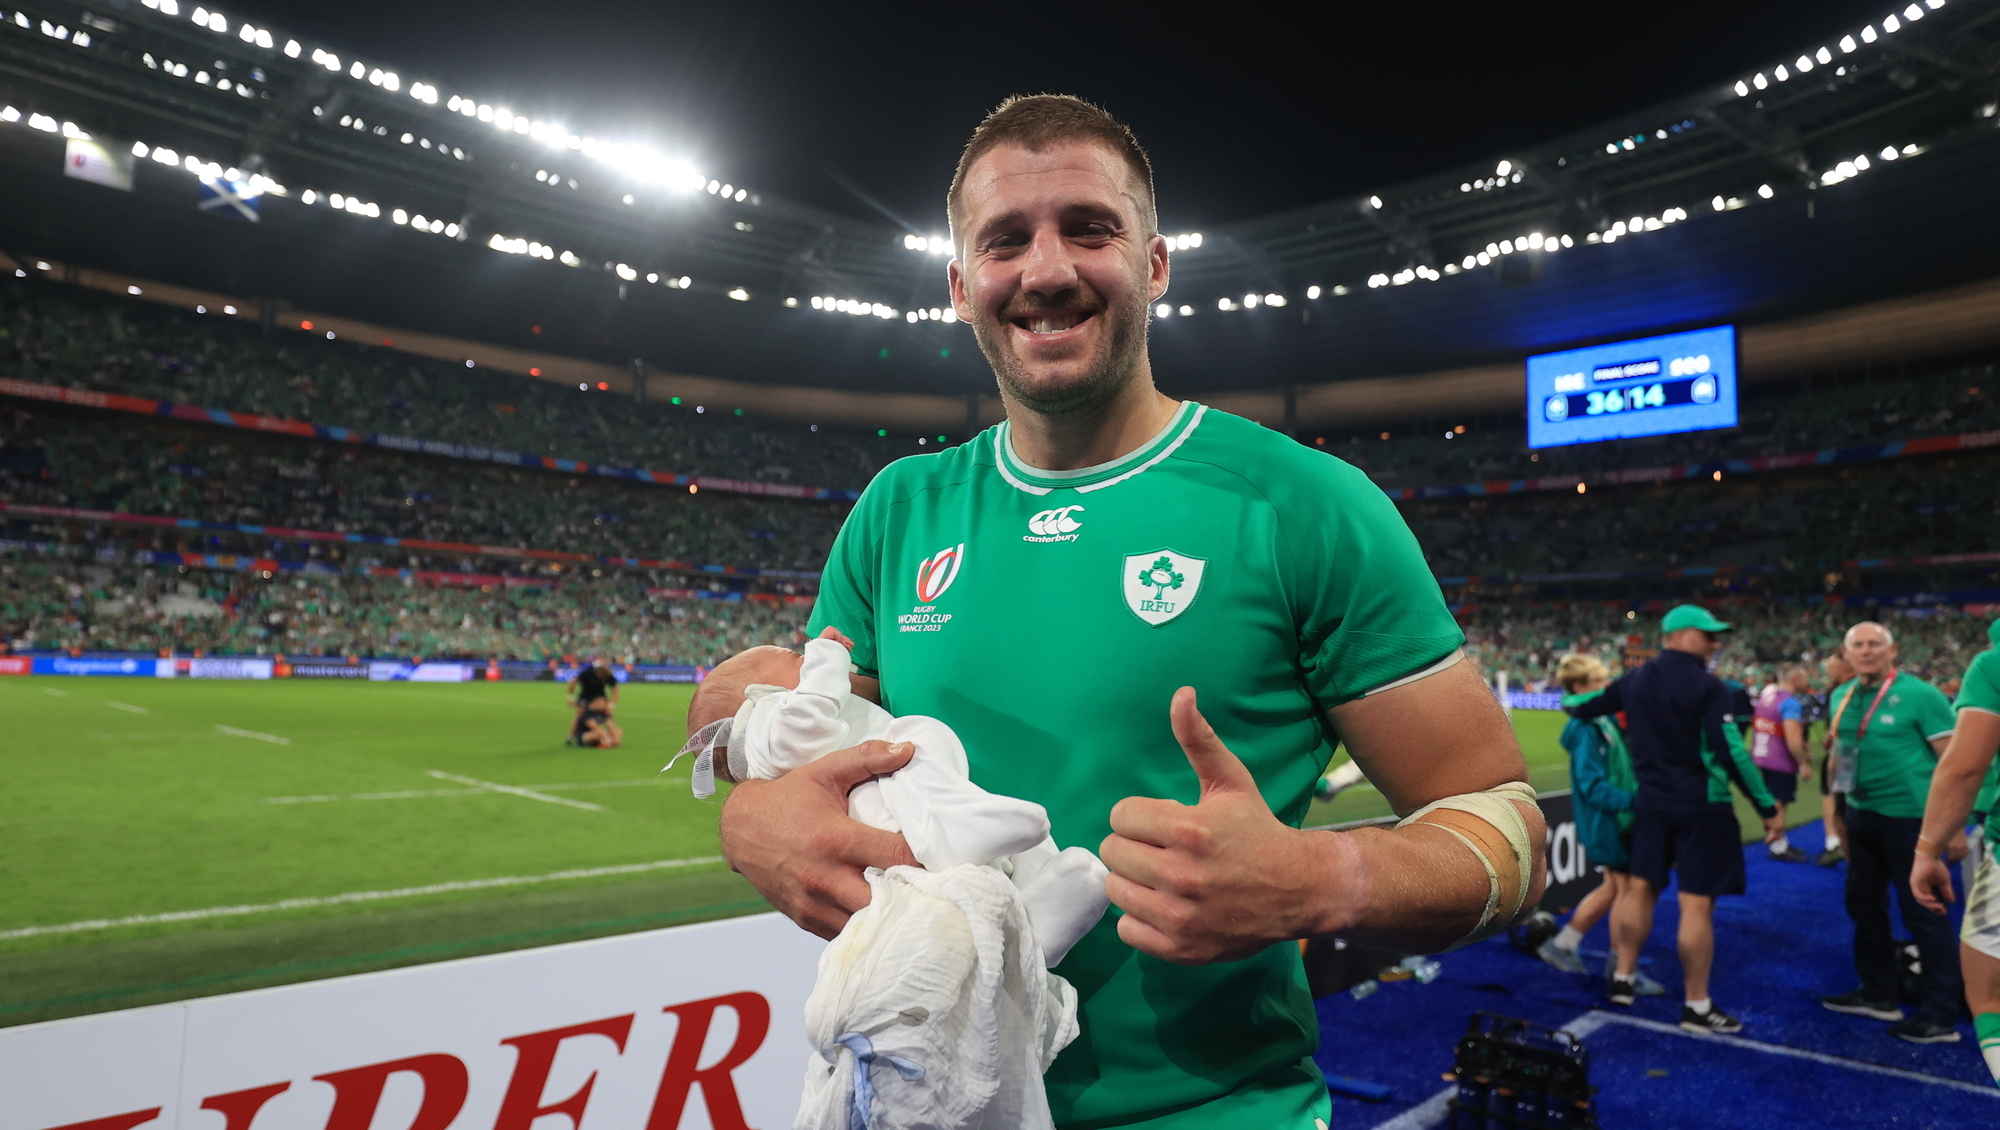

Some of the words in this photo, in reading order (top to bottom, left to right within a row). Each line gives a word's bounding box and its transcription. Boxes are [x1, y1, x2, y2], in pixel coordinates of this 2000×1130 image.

[1669, 354, 1711, 377] SCO
[1586, 389, 1624, 415] 36
[1629, 383, 1666, 410] 14
[1023, 533, 1080, 543] canterbury
[913, 605, 937, 613] RUGBY
[1139, 600, 1176, 613] IRFU
[898, 614, 930, 624] WORLD
[931, 613, 952, 623] CUP
[923, 624, 942, 632] 2023
[294, 664, 368, 678] mastercard
